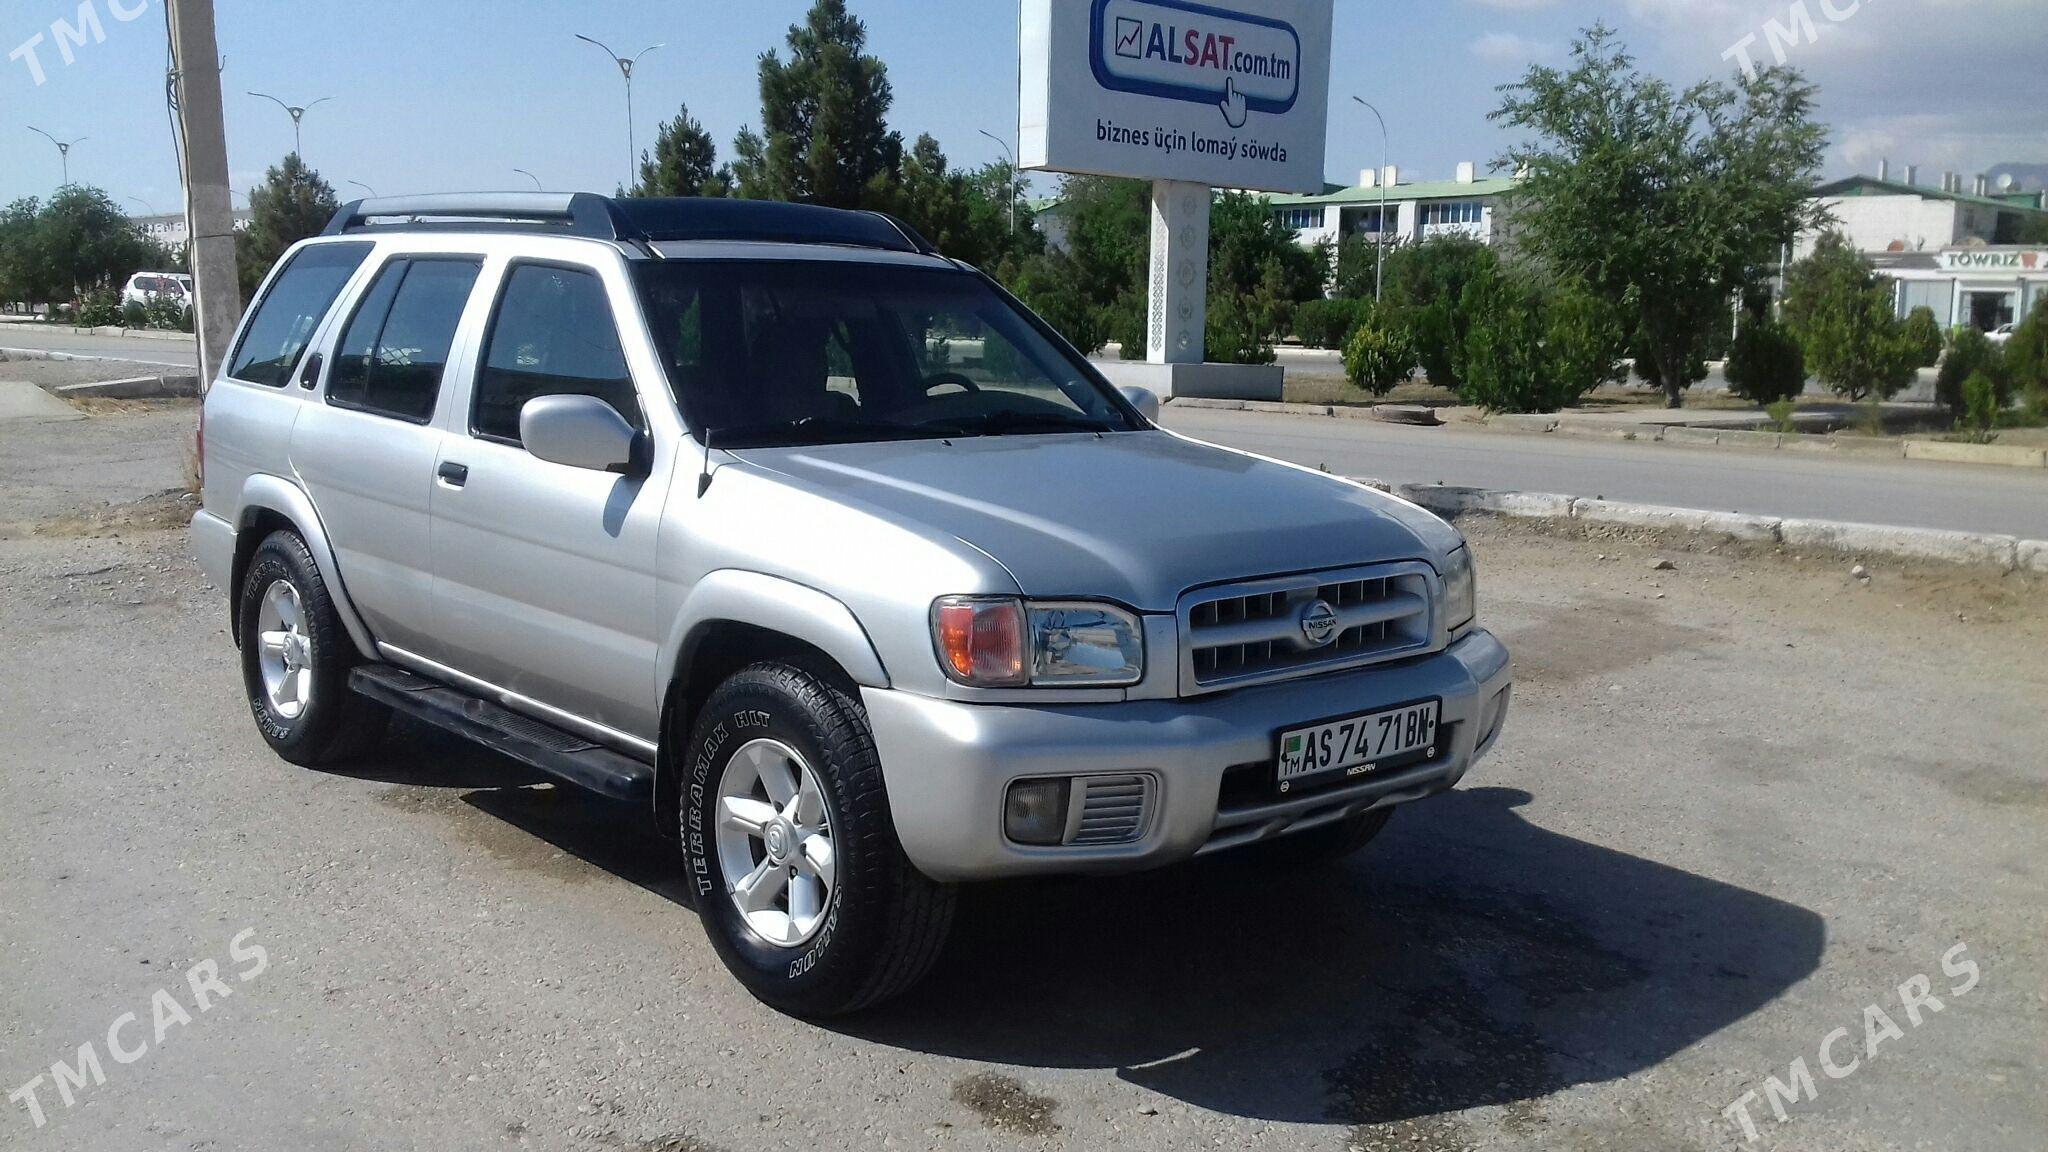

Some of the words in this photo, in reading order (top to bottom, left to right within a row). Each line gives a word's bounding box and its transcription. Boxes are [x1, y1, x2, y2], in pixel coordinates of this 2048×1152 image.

[1145, 23, 1290, 80] ALSAT.com.tm
[1096, 118, 1149, 146] biznes
[1154, 128, 1187, 154] üçin
[1191, 131, 1237, 160] lomaý
[1241, 138, 1287, 163] söwda
[1308, 618, 1336, 629] NISSAN
[1346, 763, 1377, 776] NISSAN
[689, 722, 729, 896] TERRAMAX
